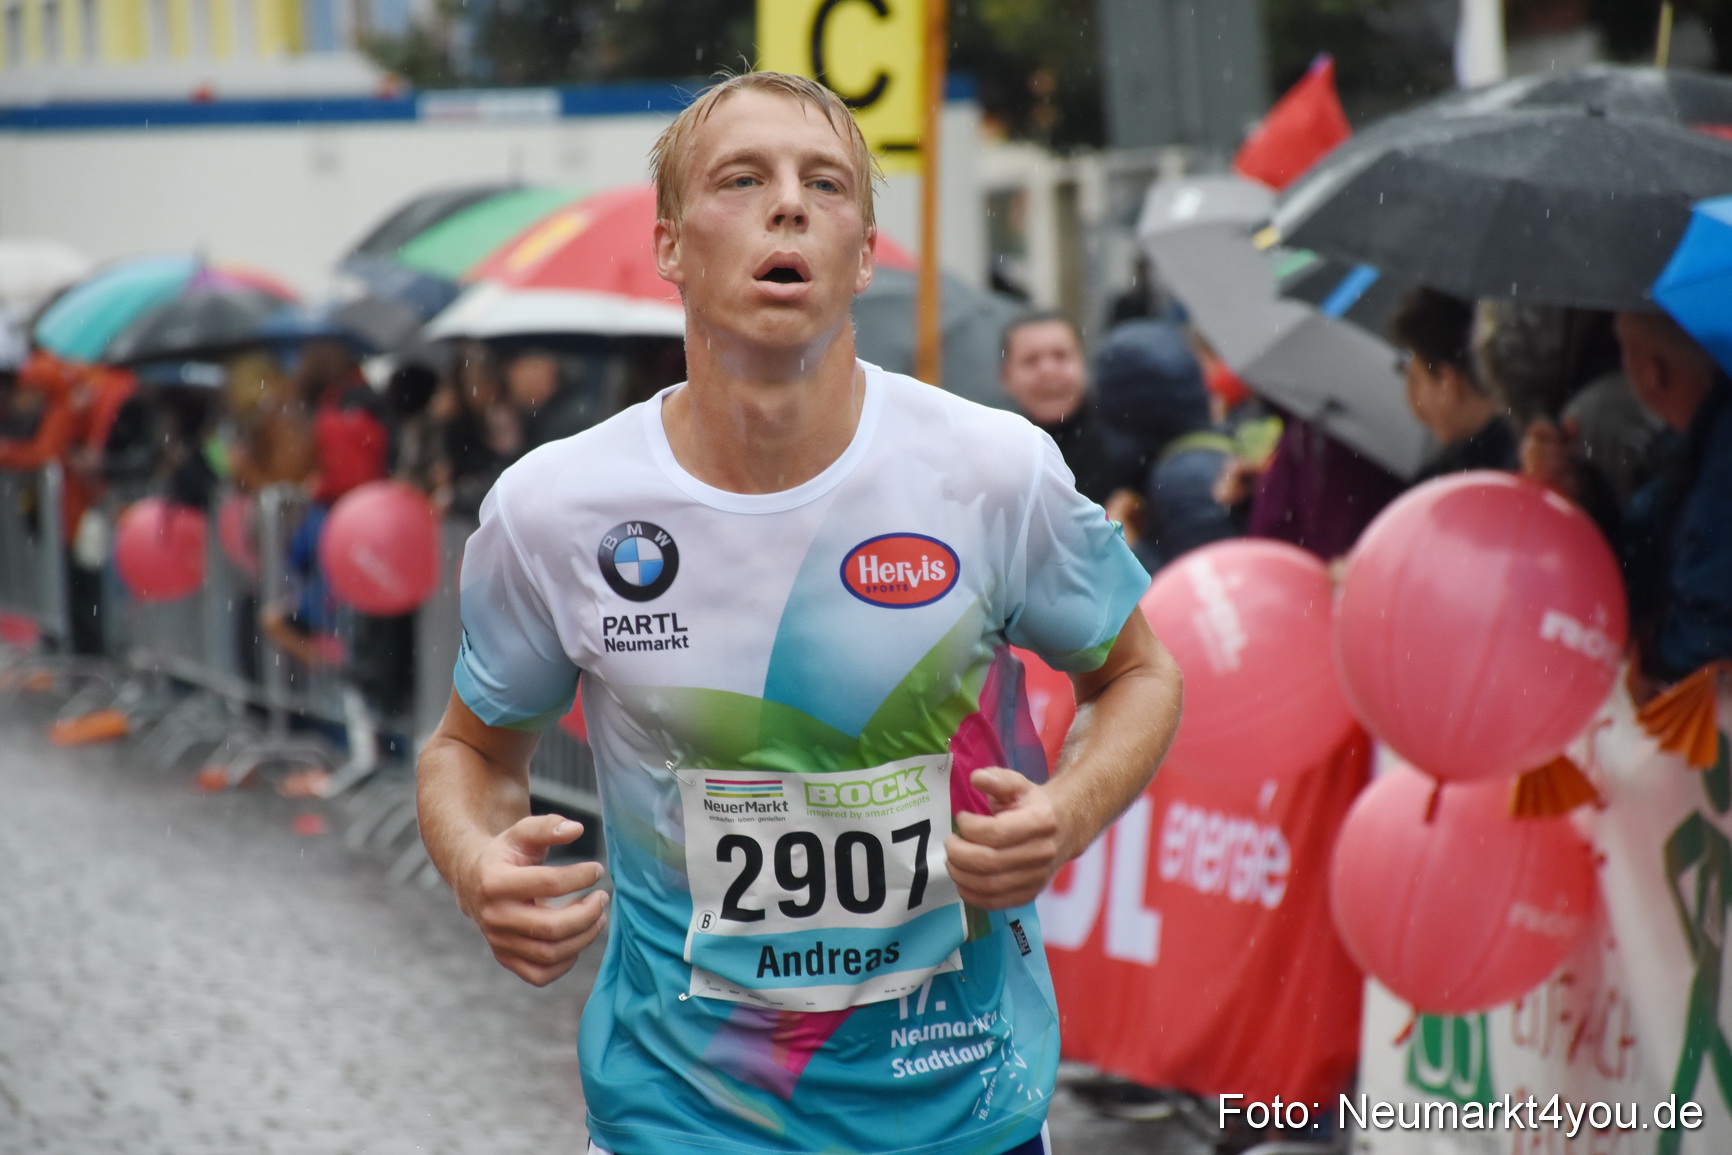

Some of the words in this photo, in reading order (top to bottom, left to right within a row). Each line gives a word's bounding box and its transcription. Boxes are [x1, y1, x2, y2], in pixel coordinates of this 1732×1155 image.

[811, 0, 889, 109] C
[602, 522, 672, 551] BMW
[858, 554, 947, 588] Hervis
[866, 584, 909, 593] SPORTS
[603, 612, 688, 637] PARTL
[604, 635, 689, 653] Neumarkt
[803, 765, 929, 809] BOCK
[703, 799, 789, 814] NeuerMarkt
[806, 807, 847, 819] inspired
[849, 810, 862, 820] by
[865, 807, 894, 818] smart
[896, 795, 931, 813] concepts
[716, 819, 932, 922] 2907
[701, 913, 711, 930] B
[756, 940, 900, 979] Andreas
[891, 1036, 997, 1078] Stadtlauf
